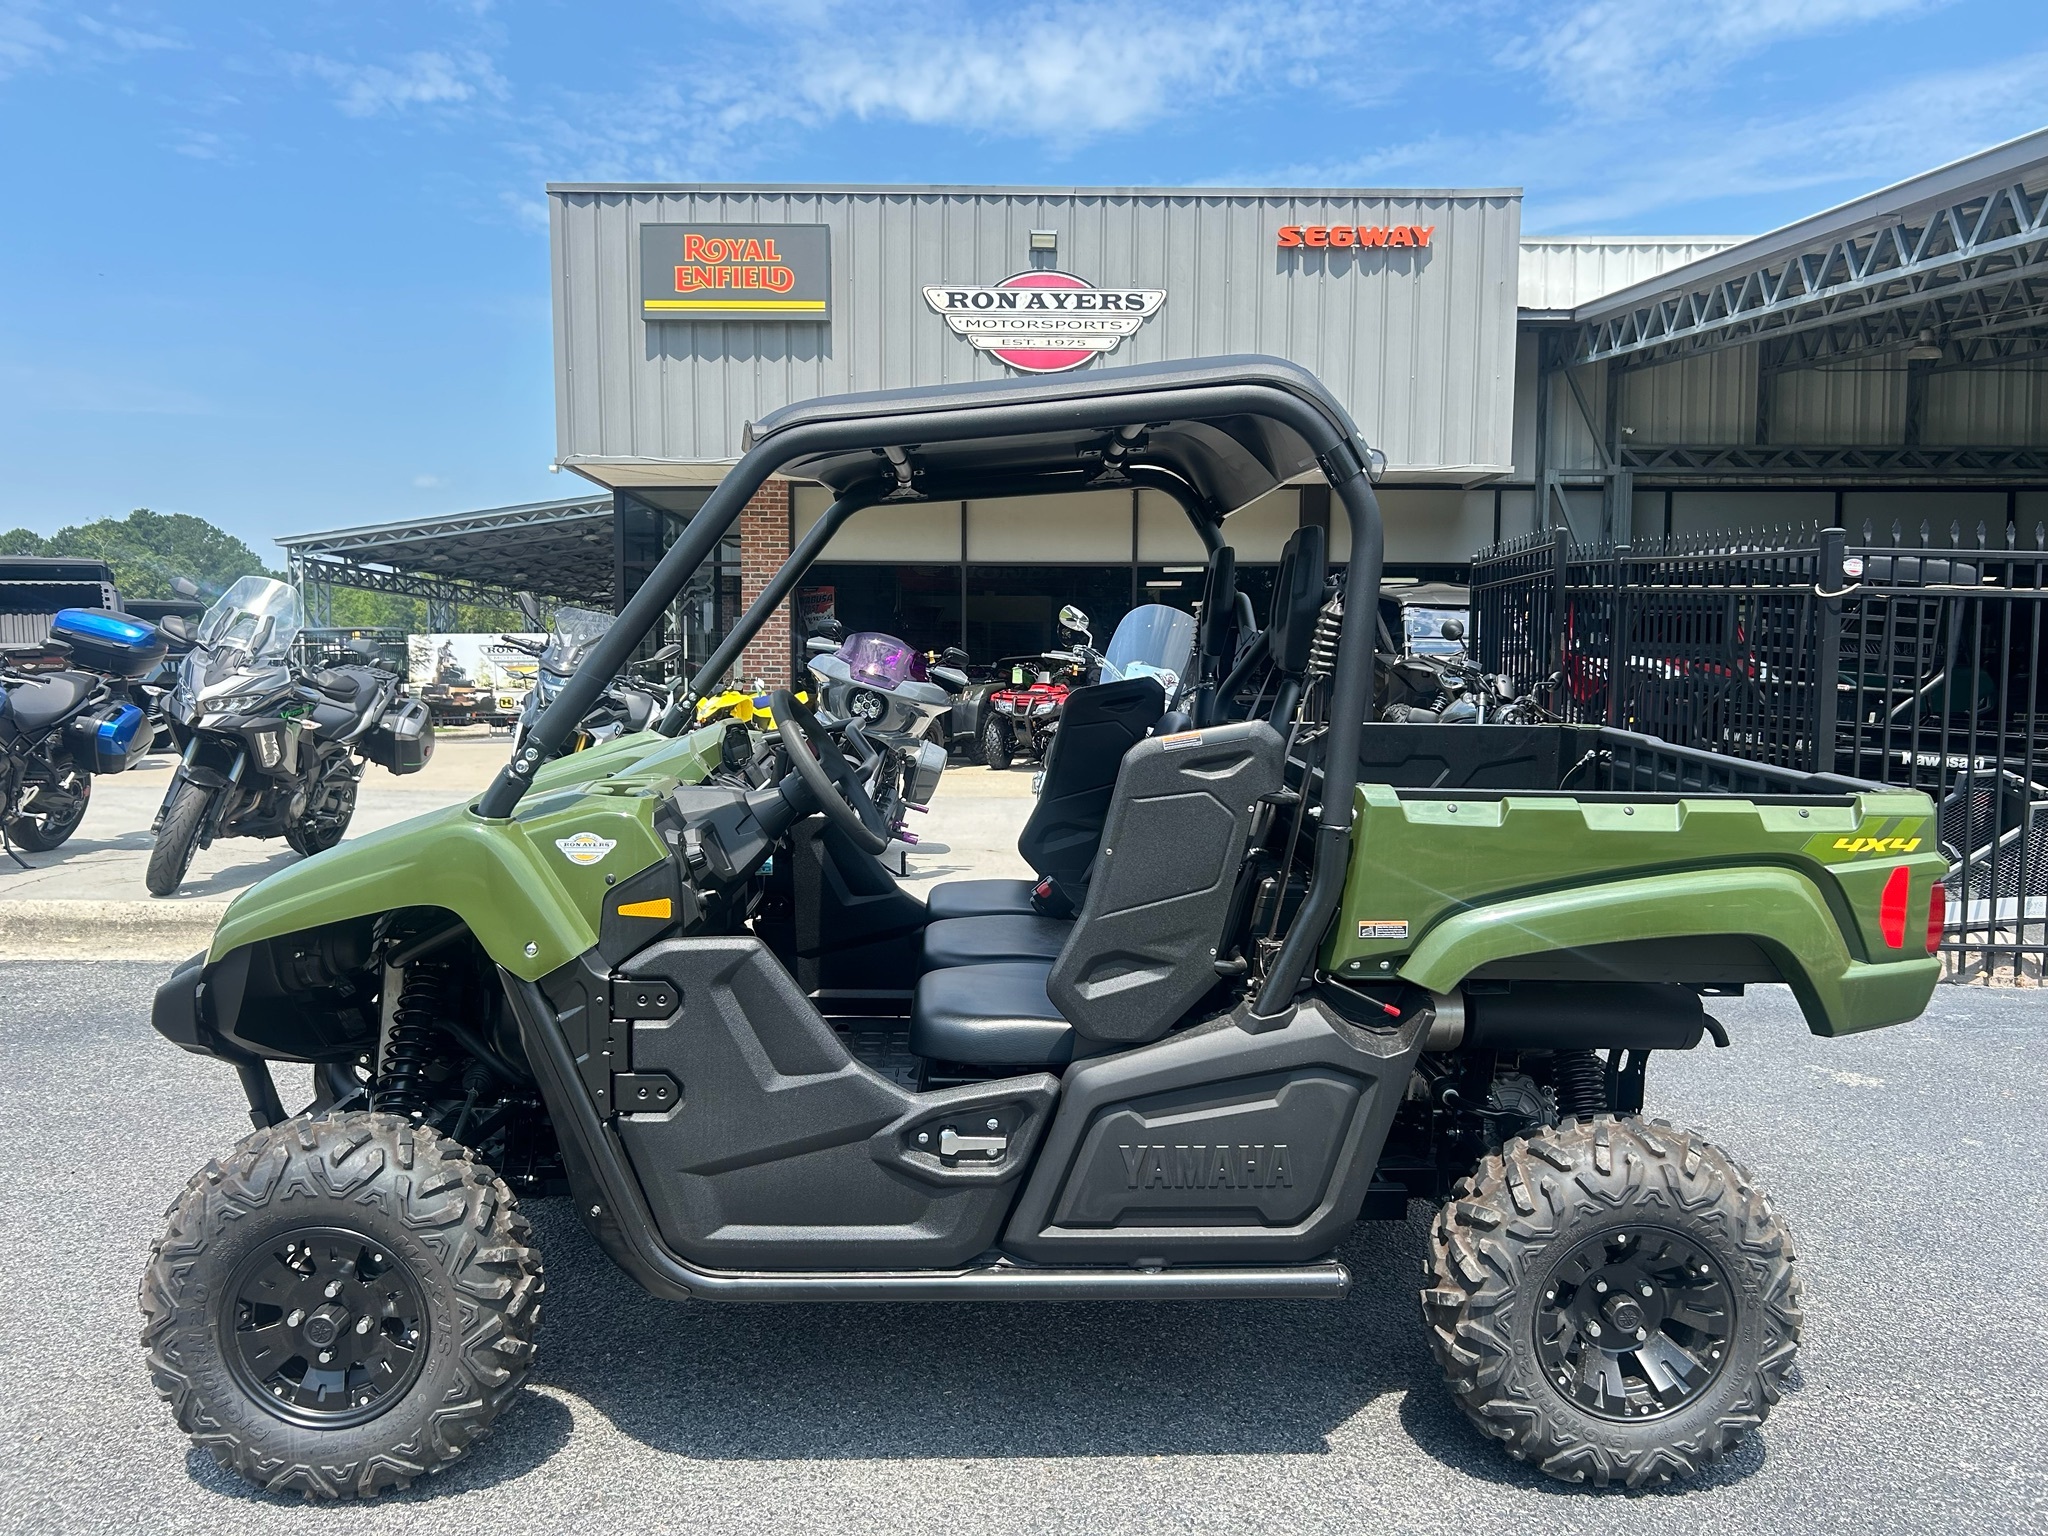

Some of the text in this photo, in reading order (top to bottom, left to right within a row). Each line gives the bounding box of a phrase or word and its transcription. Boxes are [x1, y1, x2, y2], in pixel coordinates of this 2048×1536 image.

[683, 233, 782, 265] ROYAL
[1277, 225, 1436, 248] SEGWAY
[674, 265, 796, 293] ENFIELD
[945, 291, 1145, 311] RON AYERS
[965, 319, 1123, 330] MOTORSPORTS
[1002, 338, 1086, 347] EST. 1975
[1118, 1144, 1293, 1189] YAMAHA
[391, 1233, 453, 1358] MAXXIS
[1513, 1338, 1534, 1377] 2.0
[1527, 1381, 1633, 1449] BIGHORN
